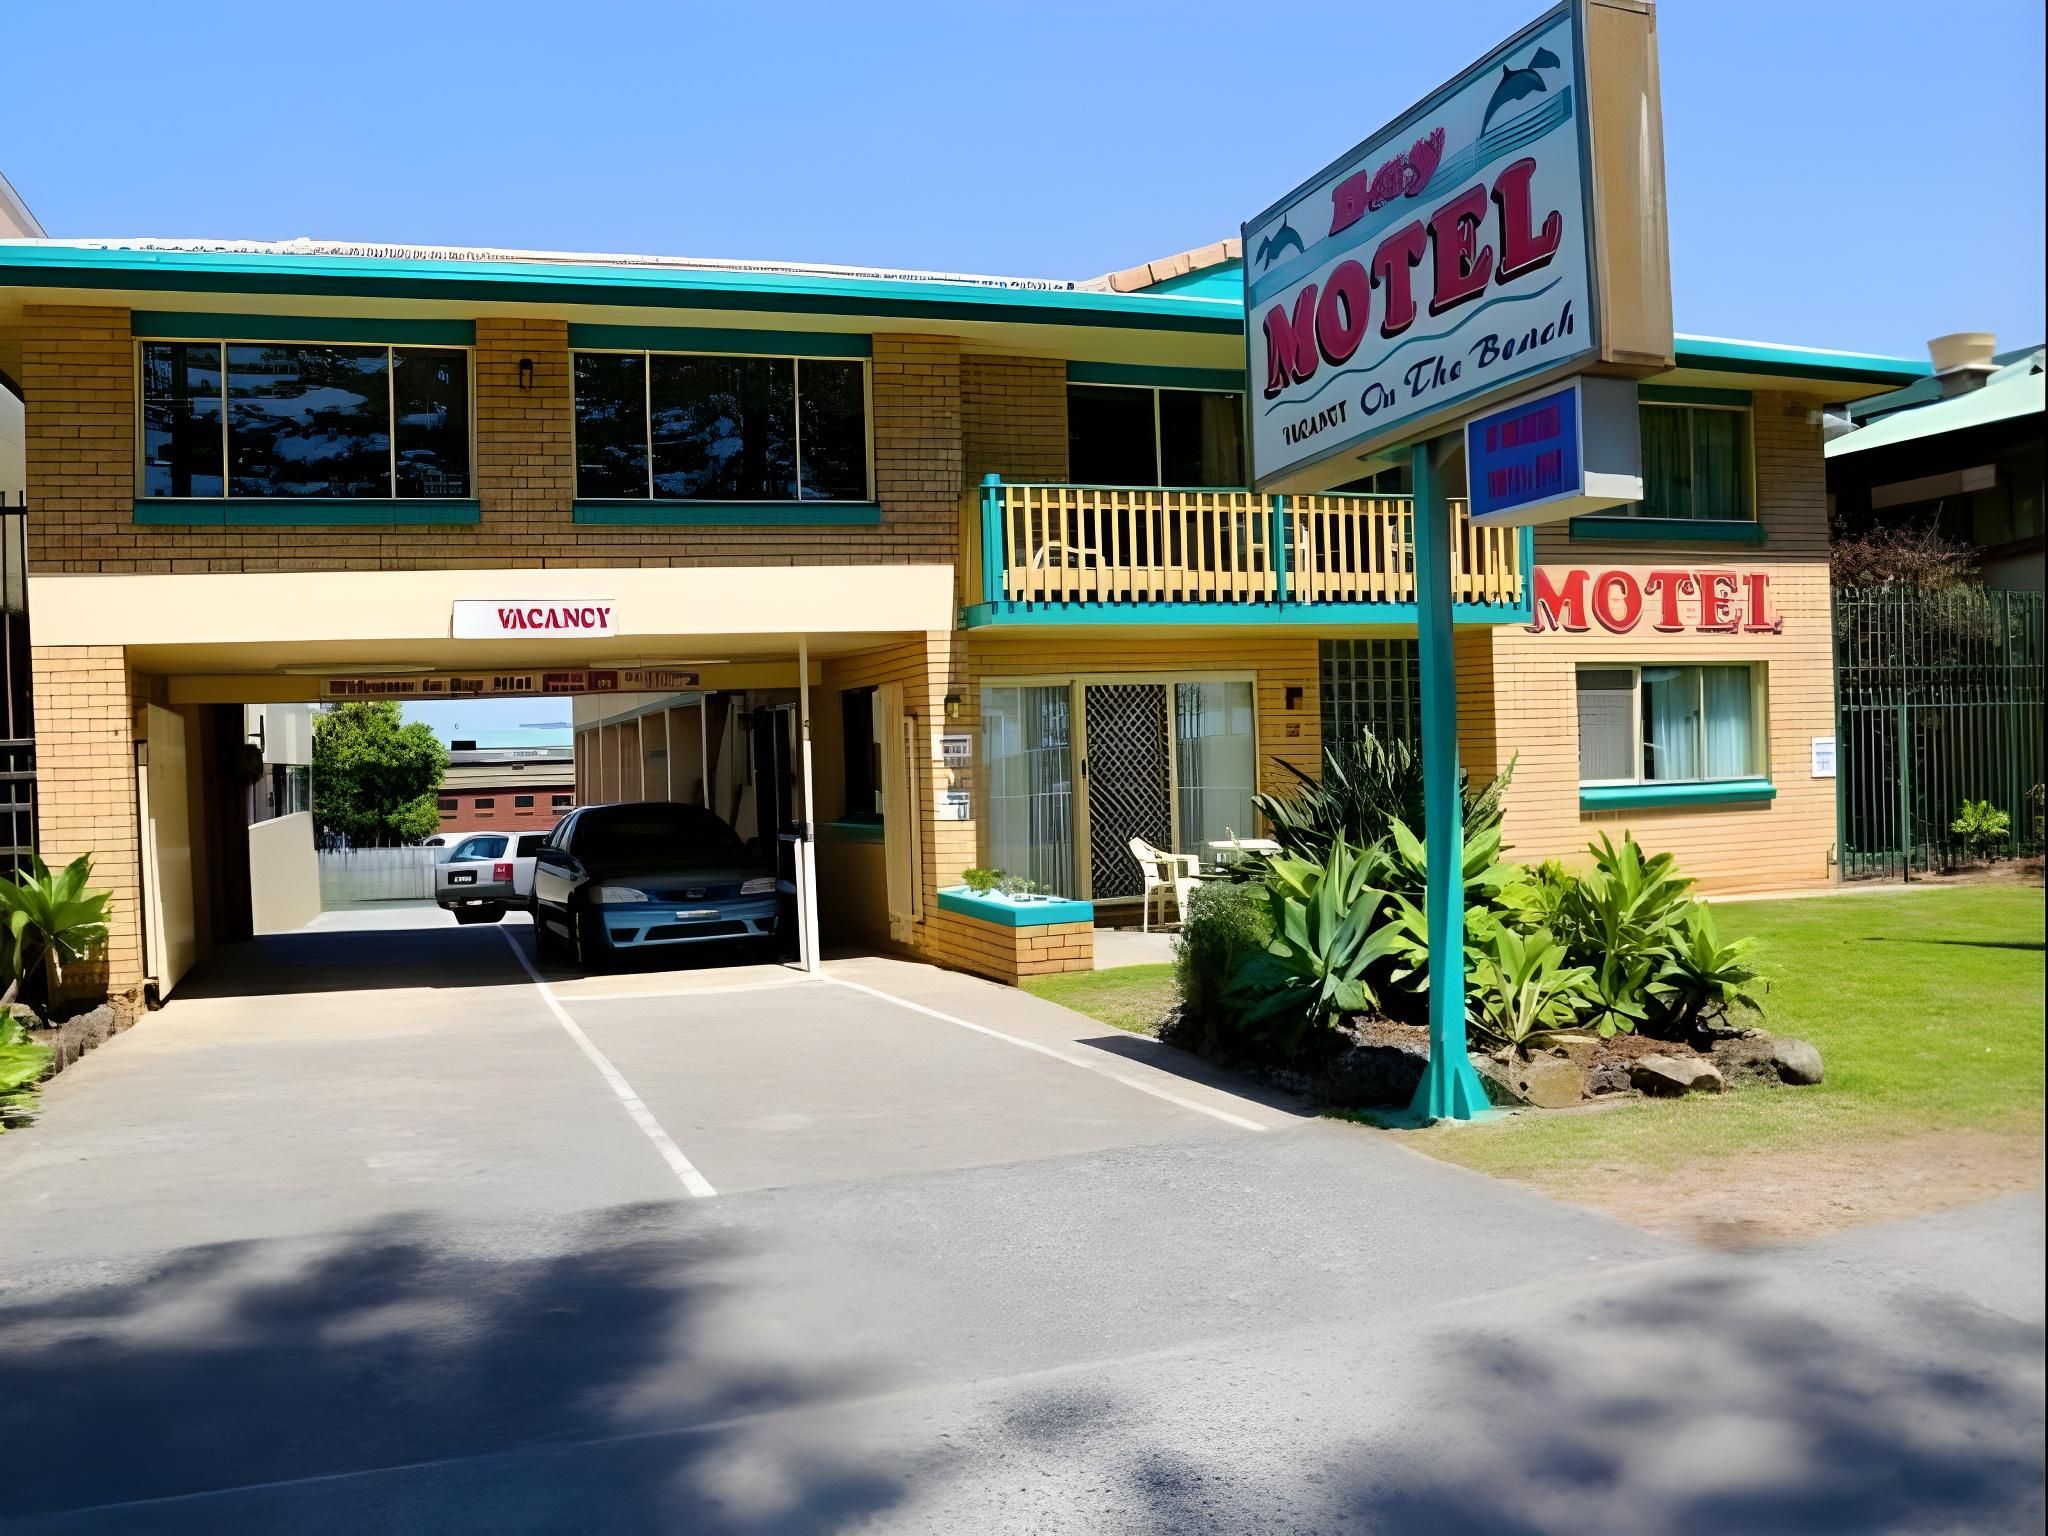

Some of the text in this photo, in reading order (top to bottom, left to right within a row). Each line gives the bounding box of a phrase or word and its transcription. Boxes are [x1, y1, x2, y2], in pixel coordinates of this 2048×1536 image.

[1263, 157, 1563, 400] MOTEL
[1360, 381, 1396, 416] On
[497, 607, 611, 630] VACANCY
